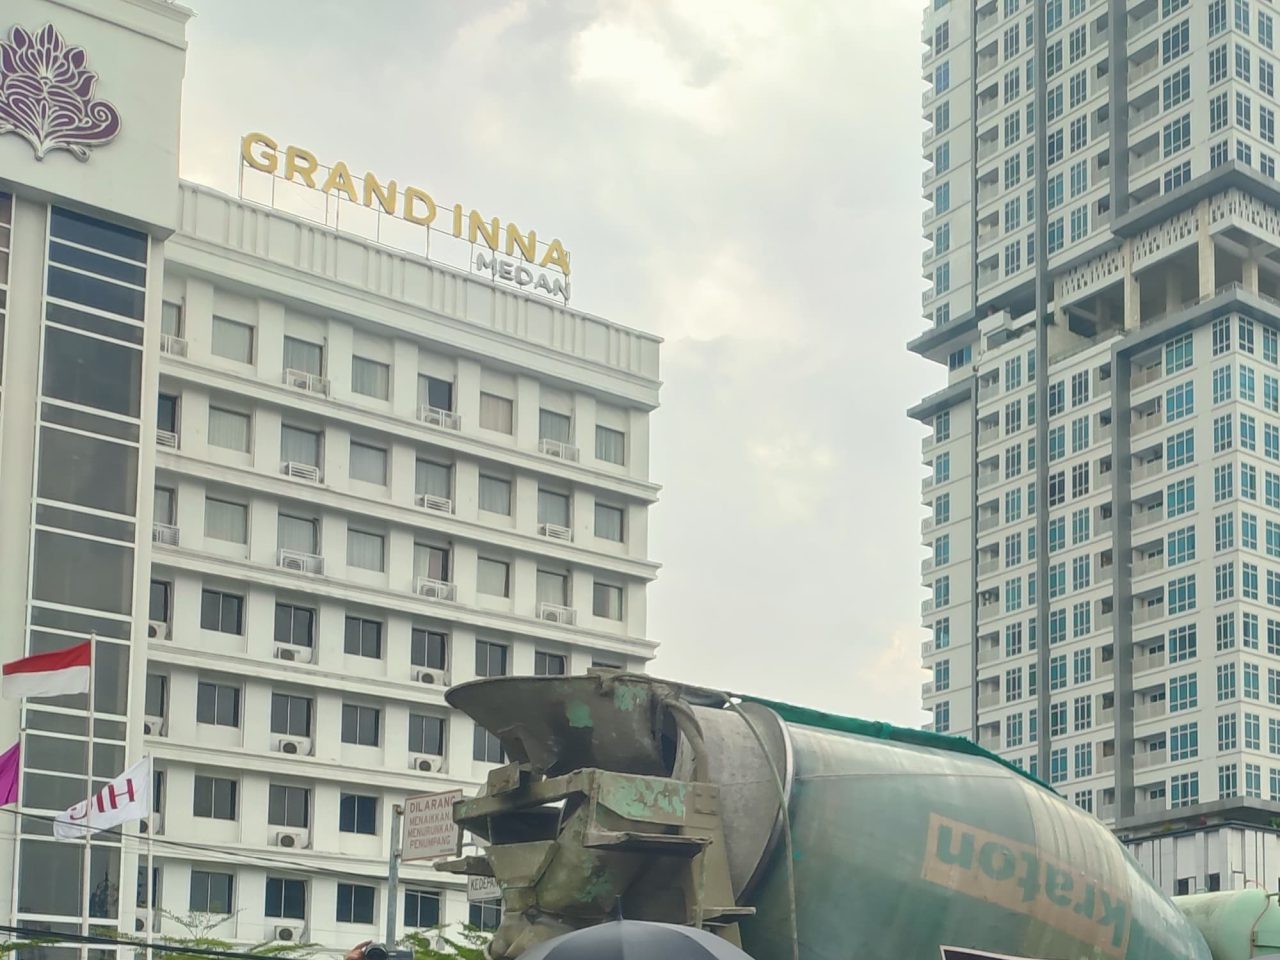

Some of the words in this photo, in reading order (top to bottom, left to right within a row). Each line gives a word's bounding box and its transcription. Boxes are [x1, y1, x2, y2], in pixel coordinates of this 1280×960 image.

[242, 132, 437, 226] GRAND
[453, 203, 570, 275] INNA
[476, 252, 570, 300] MEDAN
[936, 824, 1127, 948] kraton
